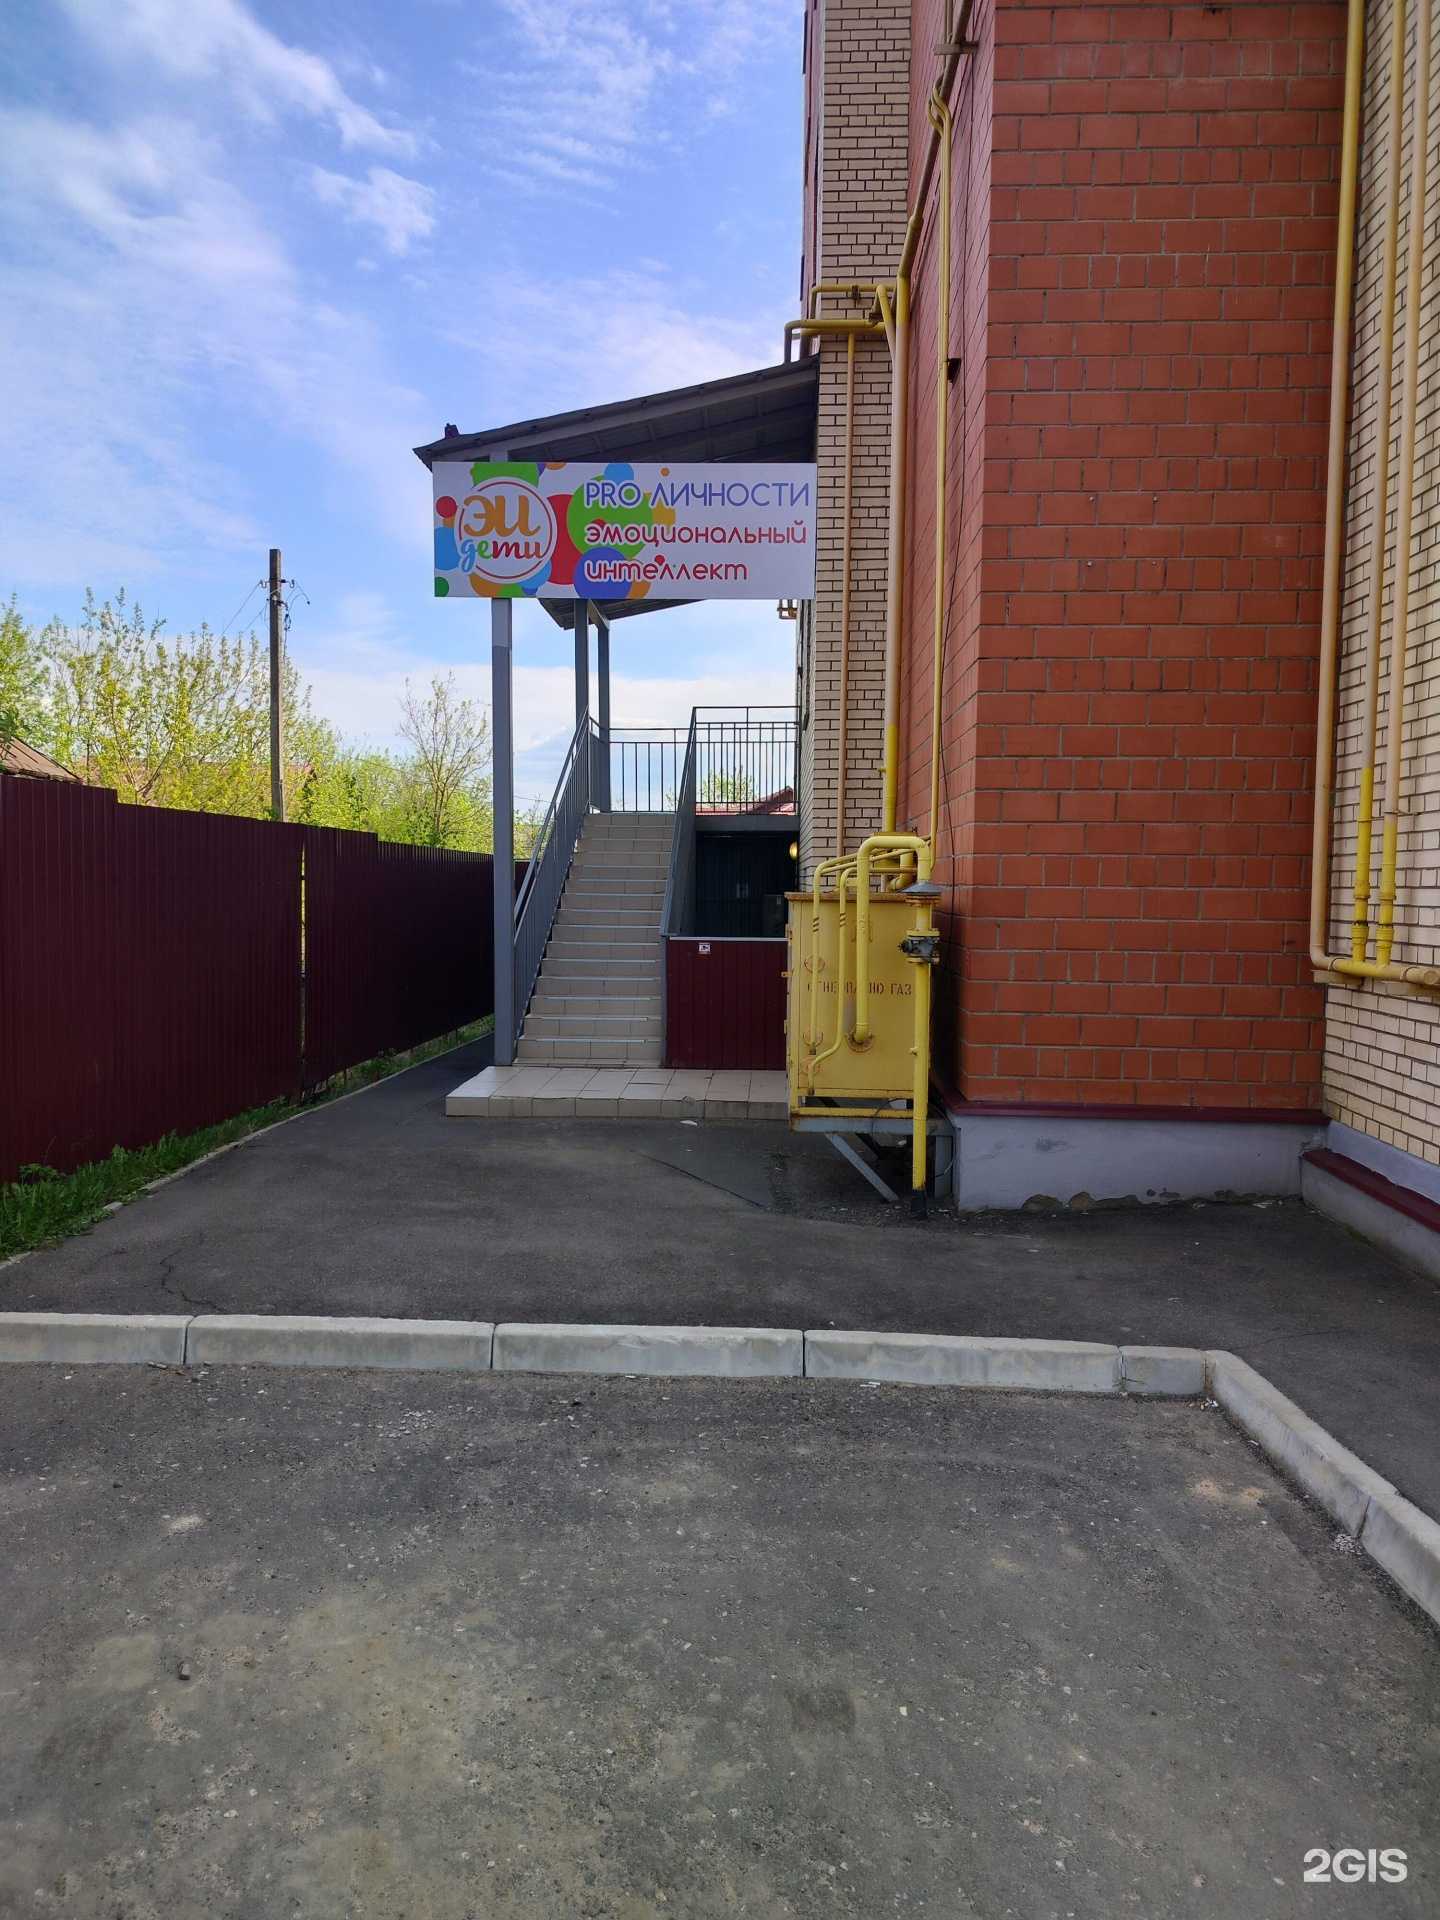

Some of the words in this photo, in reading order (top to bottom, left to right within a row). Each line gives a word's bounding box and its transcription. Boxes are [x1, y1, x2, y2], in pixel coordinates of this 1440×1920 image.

[586, 482, 641, 507] PRO
[650, 482, 809, 507] ЛИЧНОСТИ
[586, 520, 807, 547] эмоциональный
[460, 539, 543, 573] дети
[586, 562, 748, 580] интеллект
[890, 983, 912, 996] ГАЗ
